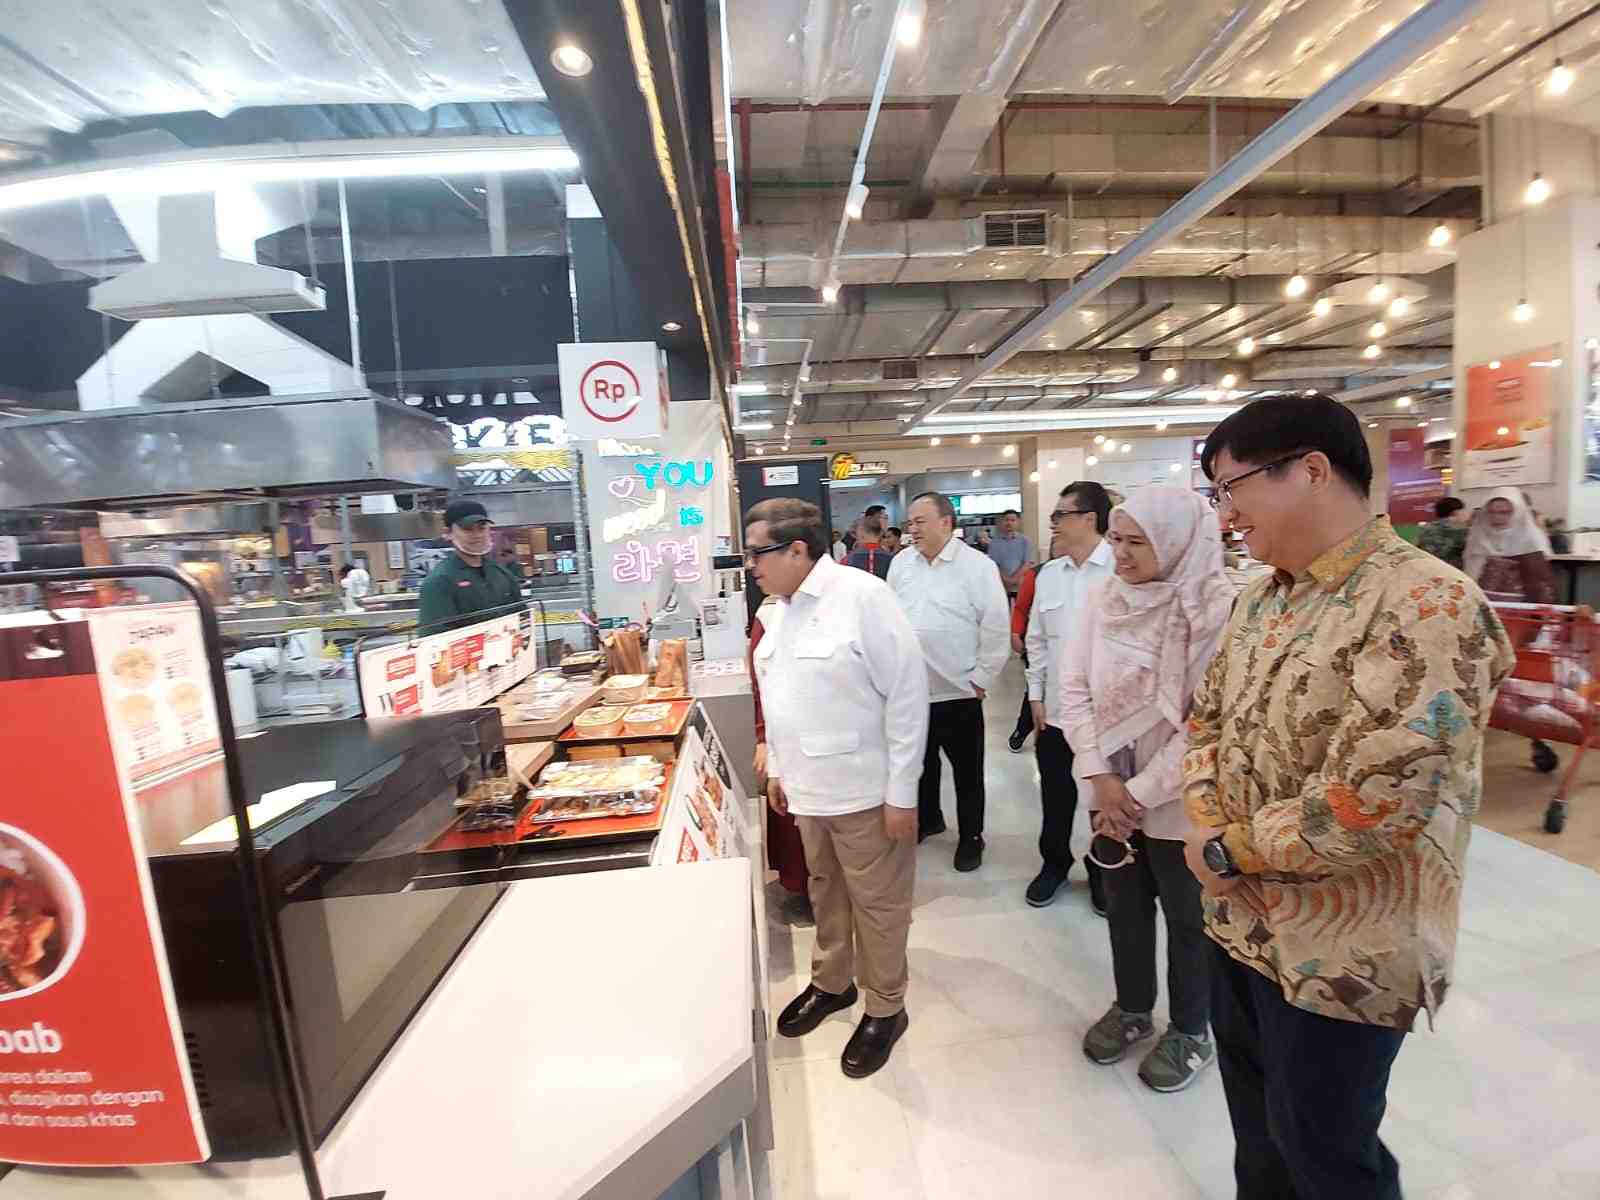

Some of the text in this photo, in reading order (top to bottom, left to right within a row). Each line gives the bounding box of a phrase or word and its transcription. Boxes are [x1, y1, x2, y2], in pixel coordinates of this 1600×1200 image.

[594, 379, 625, 403] Rp
[634, 461, 714, 489] YOU
[613, 535, 703, 583] 라면
[90, 1089, 165, 1108] dengan
[88, 1111, 137, 1127] khas
